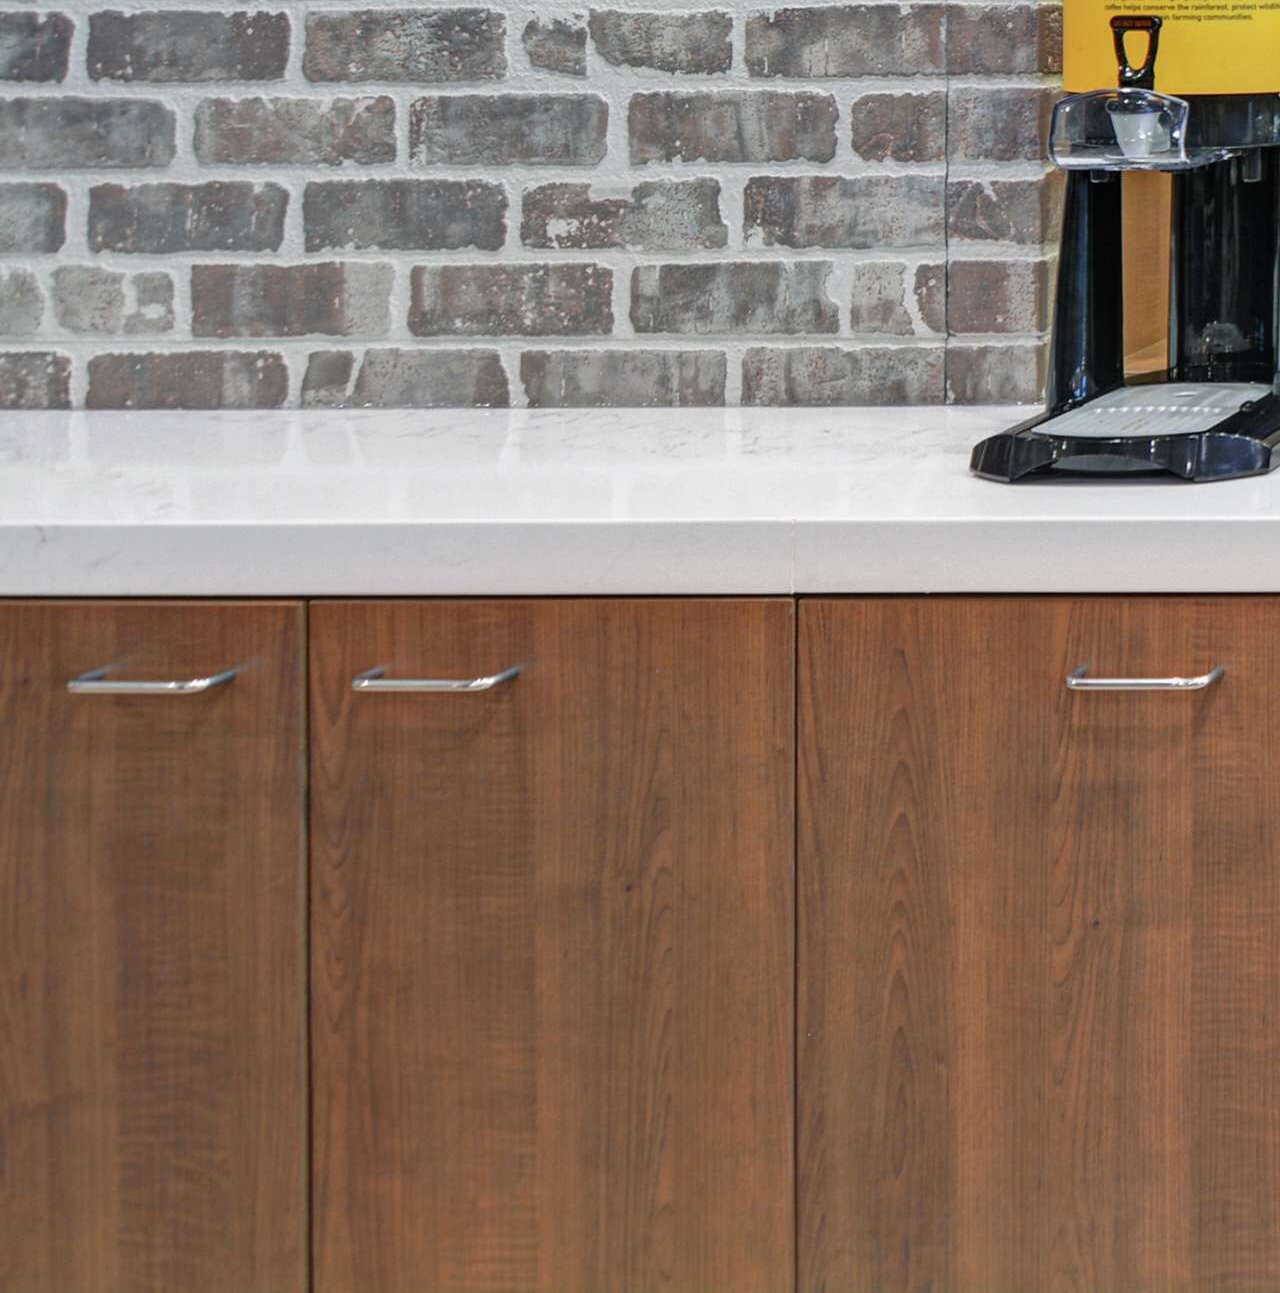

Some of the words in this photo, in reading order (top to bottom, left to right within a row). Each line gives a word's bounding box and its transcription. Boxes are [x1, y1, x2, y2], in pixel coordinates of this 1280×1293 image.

[1123, 3, 1142, 12] helps
[1143, 3, 1176, 12] conserve
[1177, 3, 1189, 12] the
[1231, 3, 1257, 12] protect
[1171, 13, 1202, 23] farming
